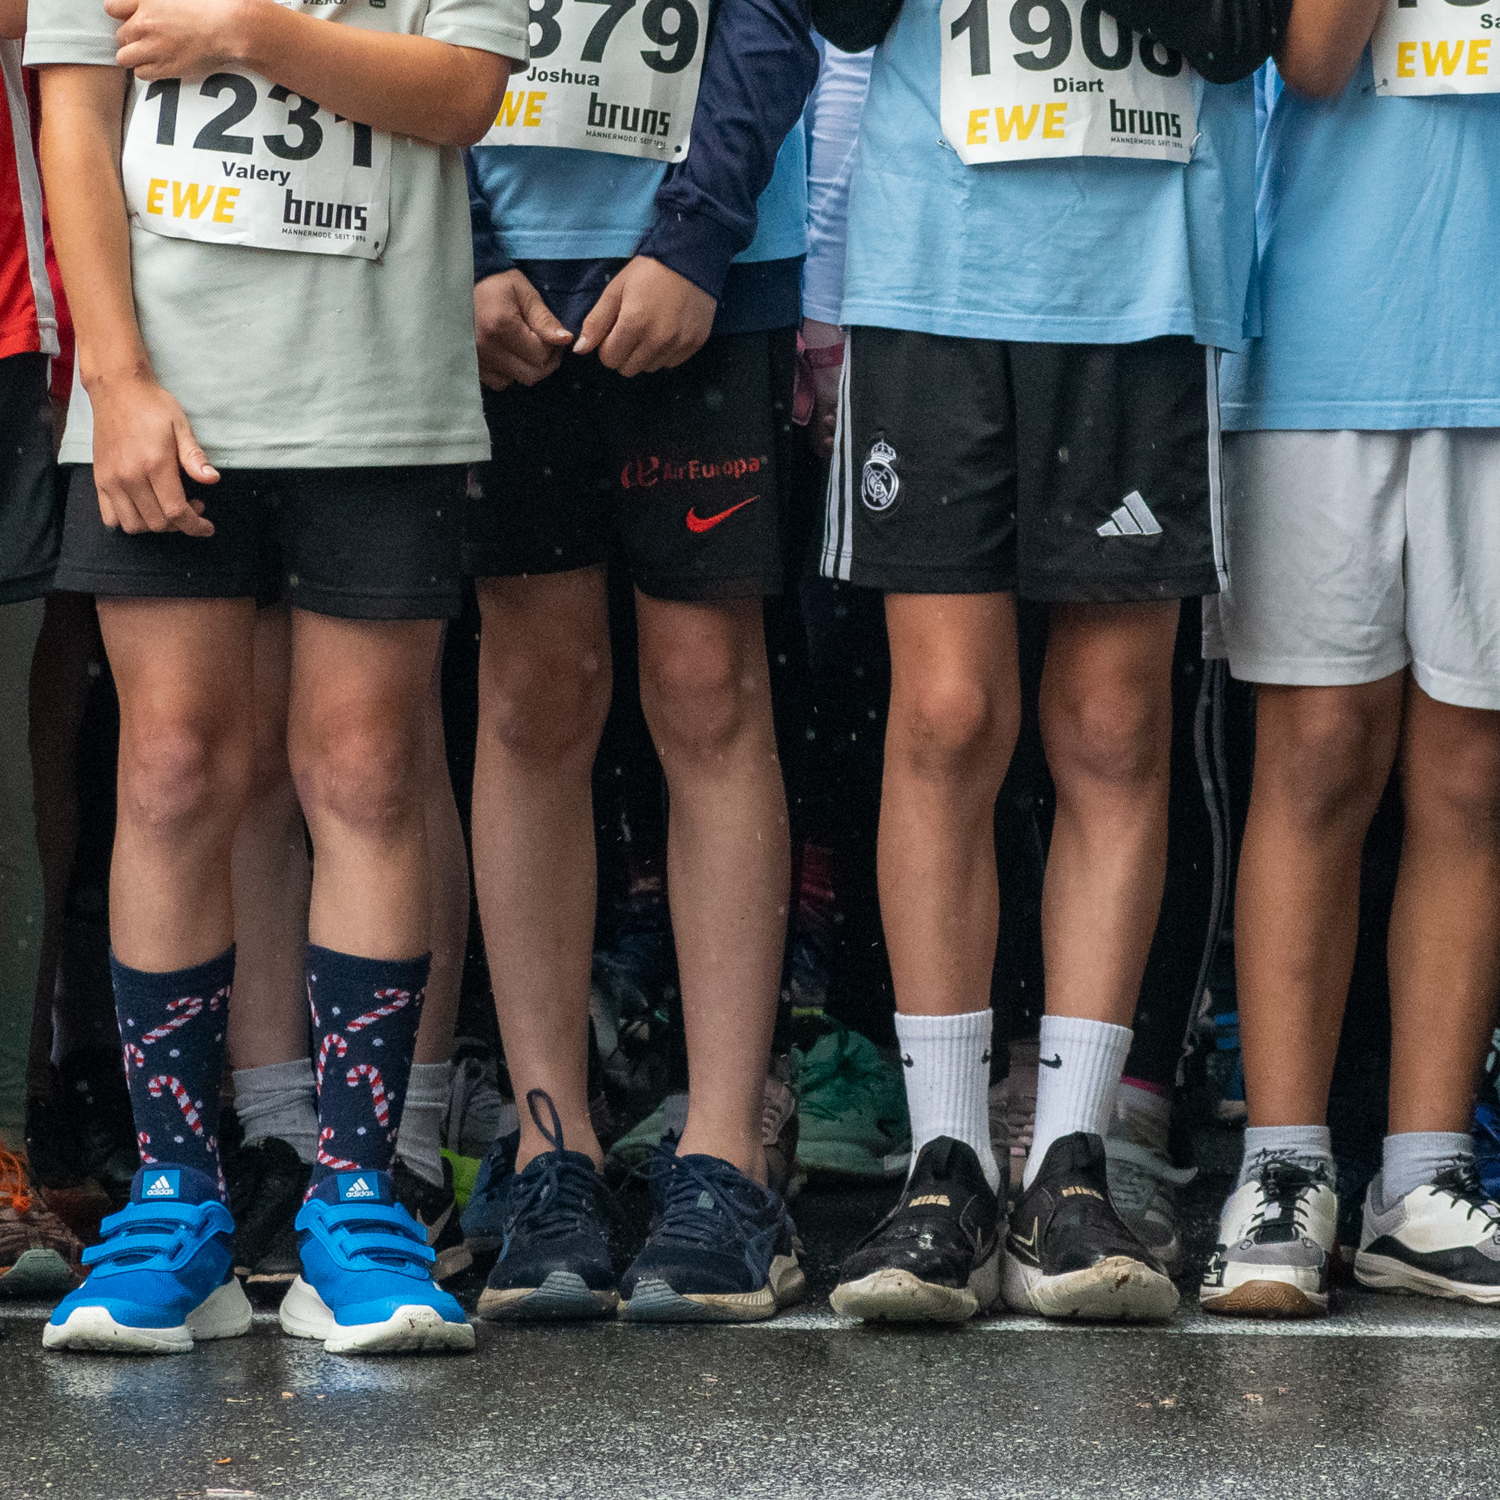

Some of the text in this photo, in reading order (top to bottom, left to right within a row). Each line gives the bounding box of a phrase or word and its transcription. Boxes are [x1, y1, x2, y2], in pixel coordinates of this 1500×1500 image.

[527, 67, 600, 86] Joshua
[1397, 38, 1491, 78] EWE
[1053, 77, 1104, 93] Diart
[494, 91, 547, 127] WE
[587, 92, 671, 137] bruns
[966, 102, 1068, 146] EWE
[1109, 98, 1182, 139] bruns
[222, 161, 291, 186] Valery
[147, 178, 241, 223] EWE
[283, 189, 367, 231] bruns
[146, 1188, 175, 1196] adidas
[345, 1190, 375, 1198] adidas
